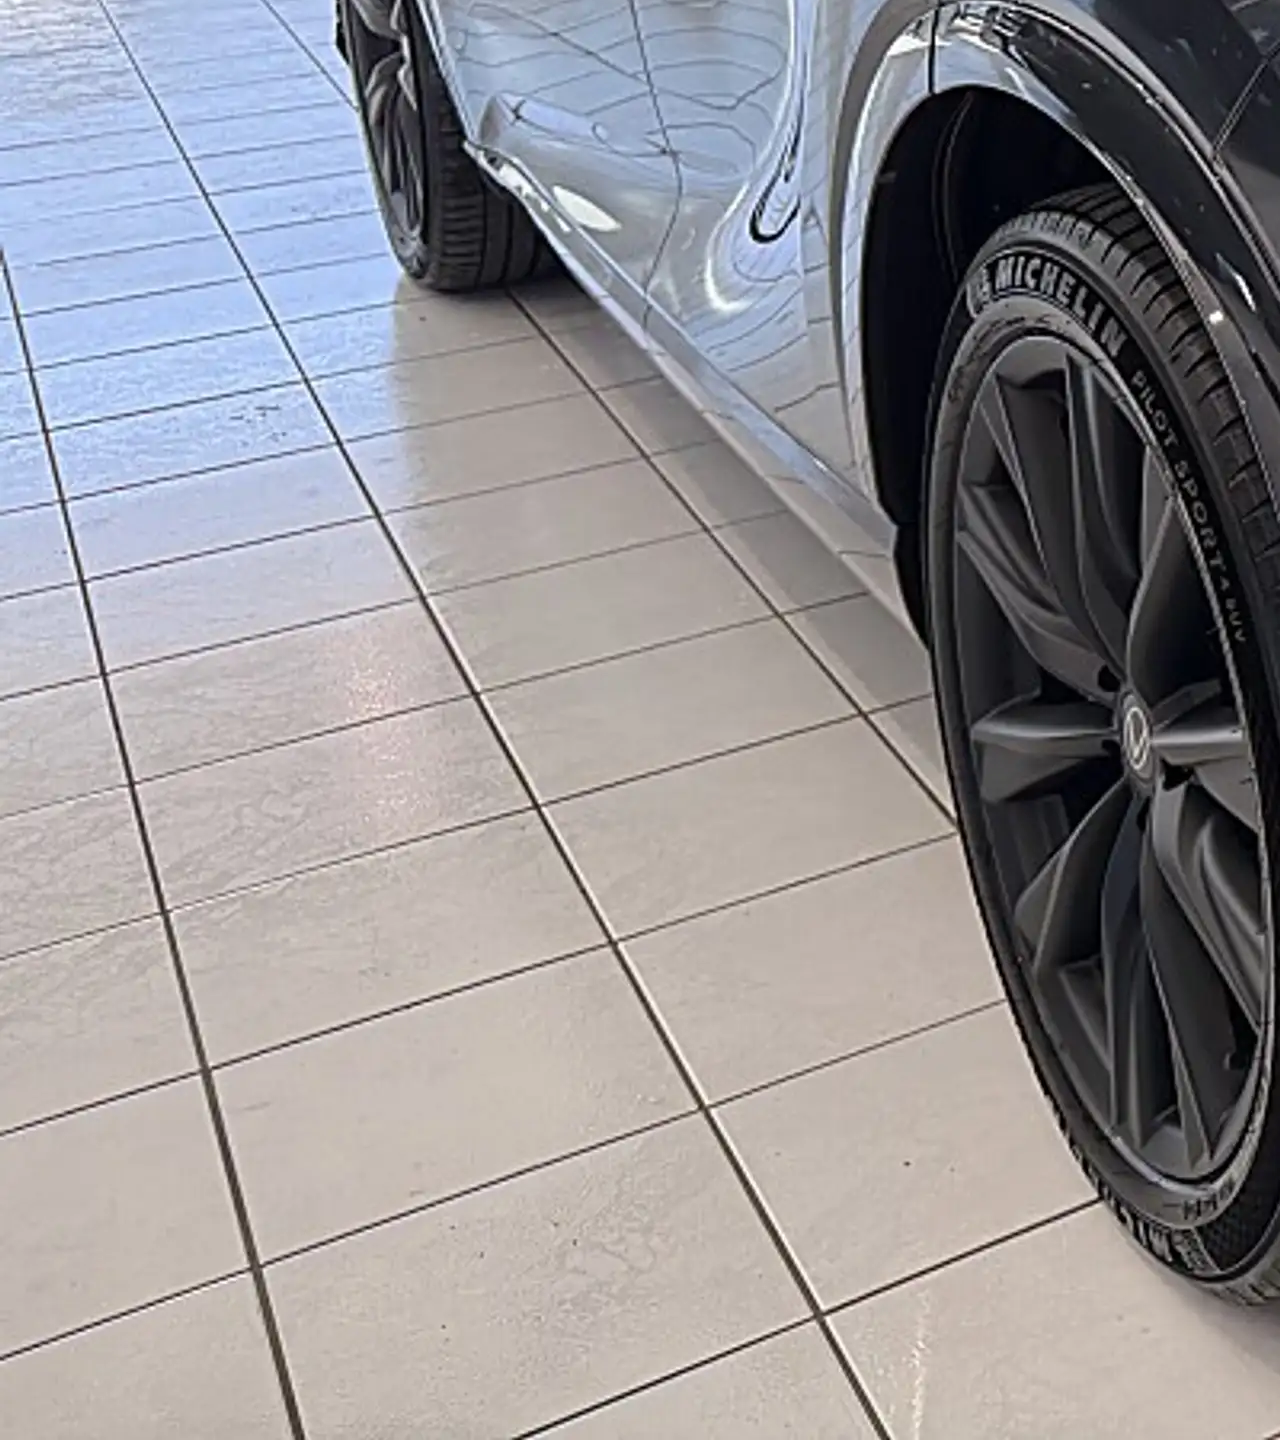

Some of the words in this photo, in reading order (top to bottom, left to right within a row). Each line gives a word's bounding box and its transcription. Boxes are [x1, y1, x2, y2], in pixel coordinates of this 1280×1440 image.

[995, 255, 1128, 358] MICHELIN
[1130, 370, 1179, 448] PILOT
[1174, 460, 1227, 572] SPORT
